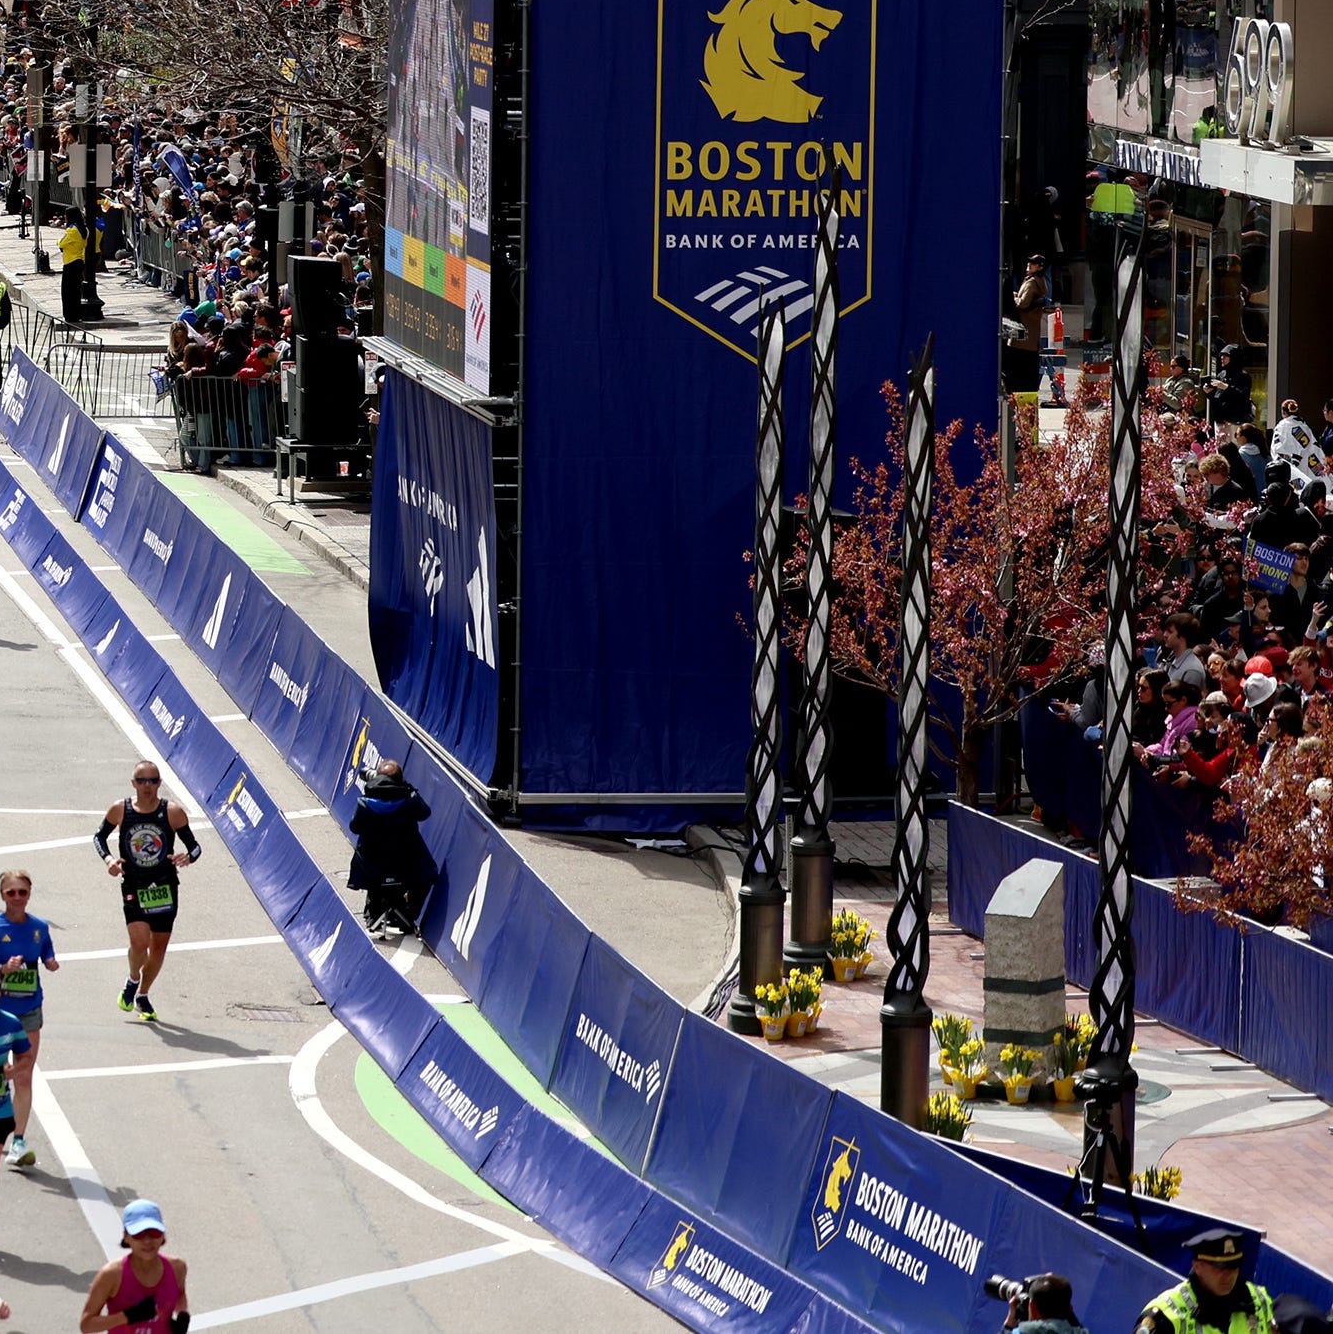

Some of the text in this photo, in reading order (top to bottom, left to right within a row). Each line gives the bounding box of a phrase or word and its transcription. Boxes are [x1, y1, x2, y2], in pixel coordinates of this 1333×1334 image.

[666, 141, 862, 181] BOSTON
[1115, 139, 1147, 173] BANK
[1145, 147, 1158, 176] OF
[665, 234, 860, 248] BANK OF AMERCA
[1254, 545, 1294, 569] BOSTON
[1257, 562, 1289, 582] TRONG
[576, 1012, 645, 1093] BANK OF AMERICA
[419, 1059, 482, 1132] BANK OF AMERICA
[854, 1171, 984, 1276] BOSTON MARATHON
[845, 1218, 929, 1286] BANK OF AMERICA
[671, 1274, 730, 1318] BANK OF AMERICA
[684, 1244, 773, 1315] BOSTON MARATHON
